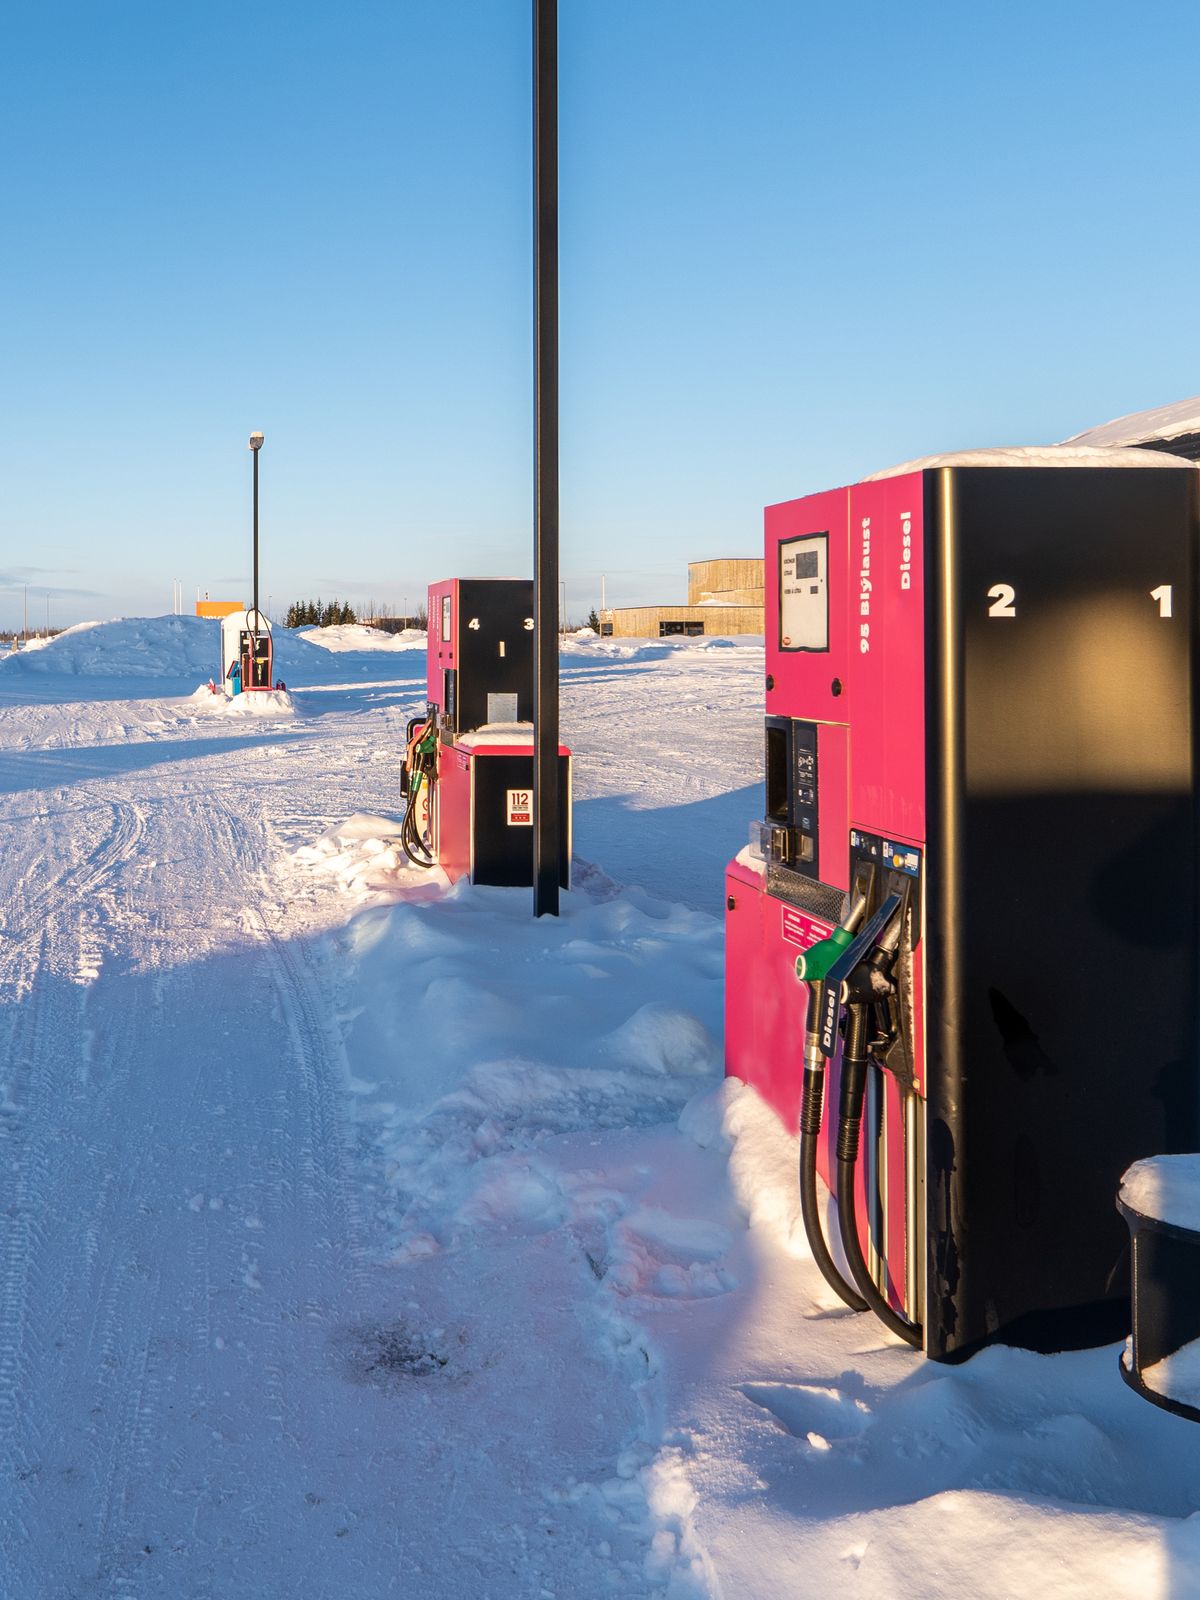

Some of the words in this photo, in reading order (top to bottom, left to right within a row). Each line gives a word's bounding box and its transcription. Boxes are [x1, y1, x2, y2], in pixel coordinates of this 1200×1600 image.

[860, 517, 872, 616] Blýlaust
[900, 512, 911, 590] Diesel
[987, 583, 1016, 617] 2
[1149, 585, 1172, 617] 1
[468, 618, 480, 631] 4
[523, 617, 535, 631] 3
[860, 623, 870, 654] 95
[511, 793, 529, 805] 112
[823, 989, 836, 1048] Diesel
